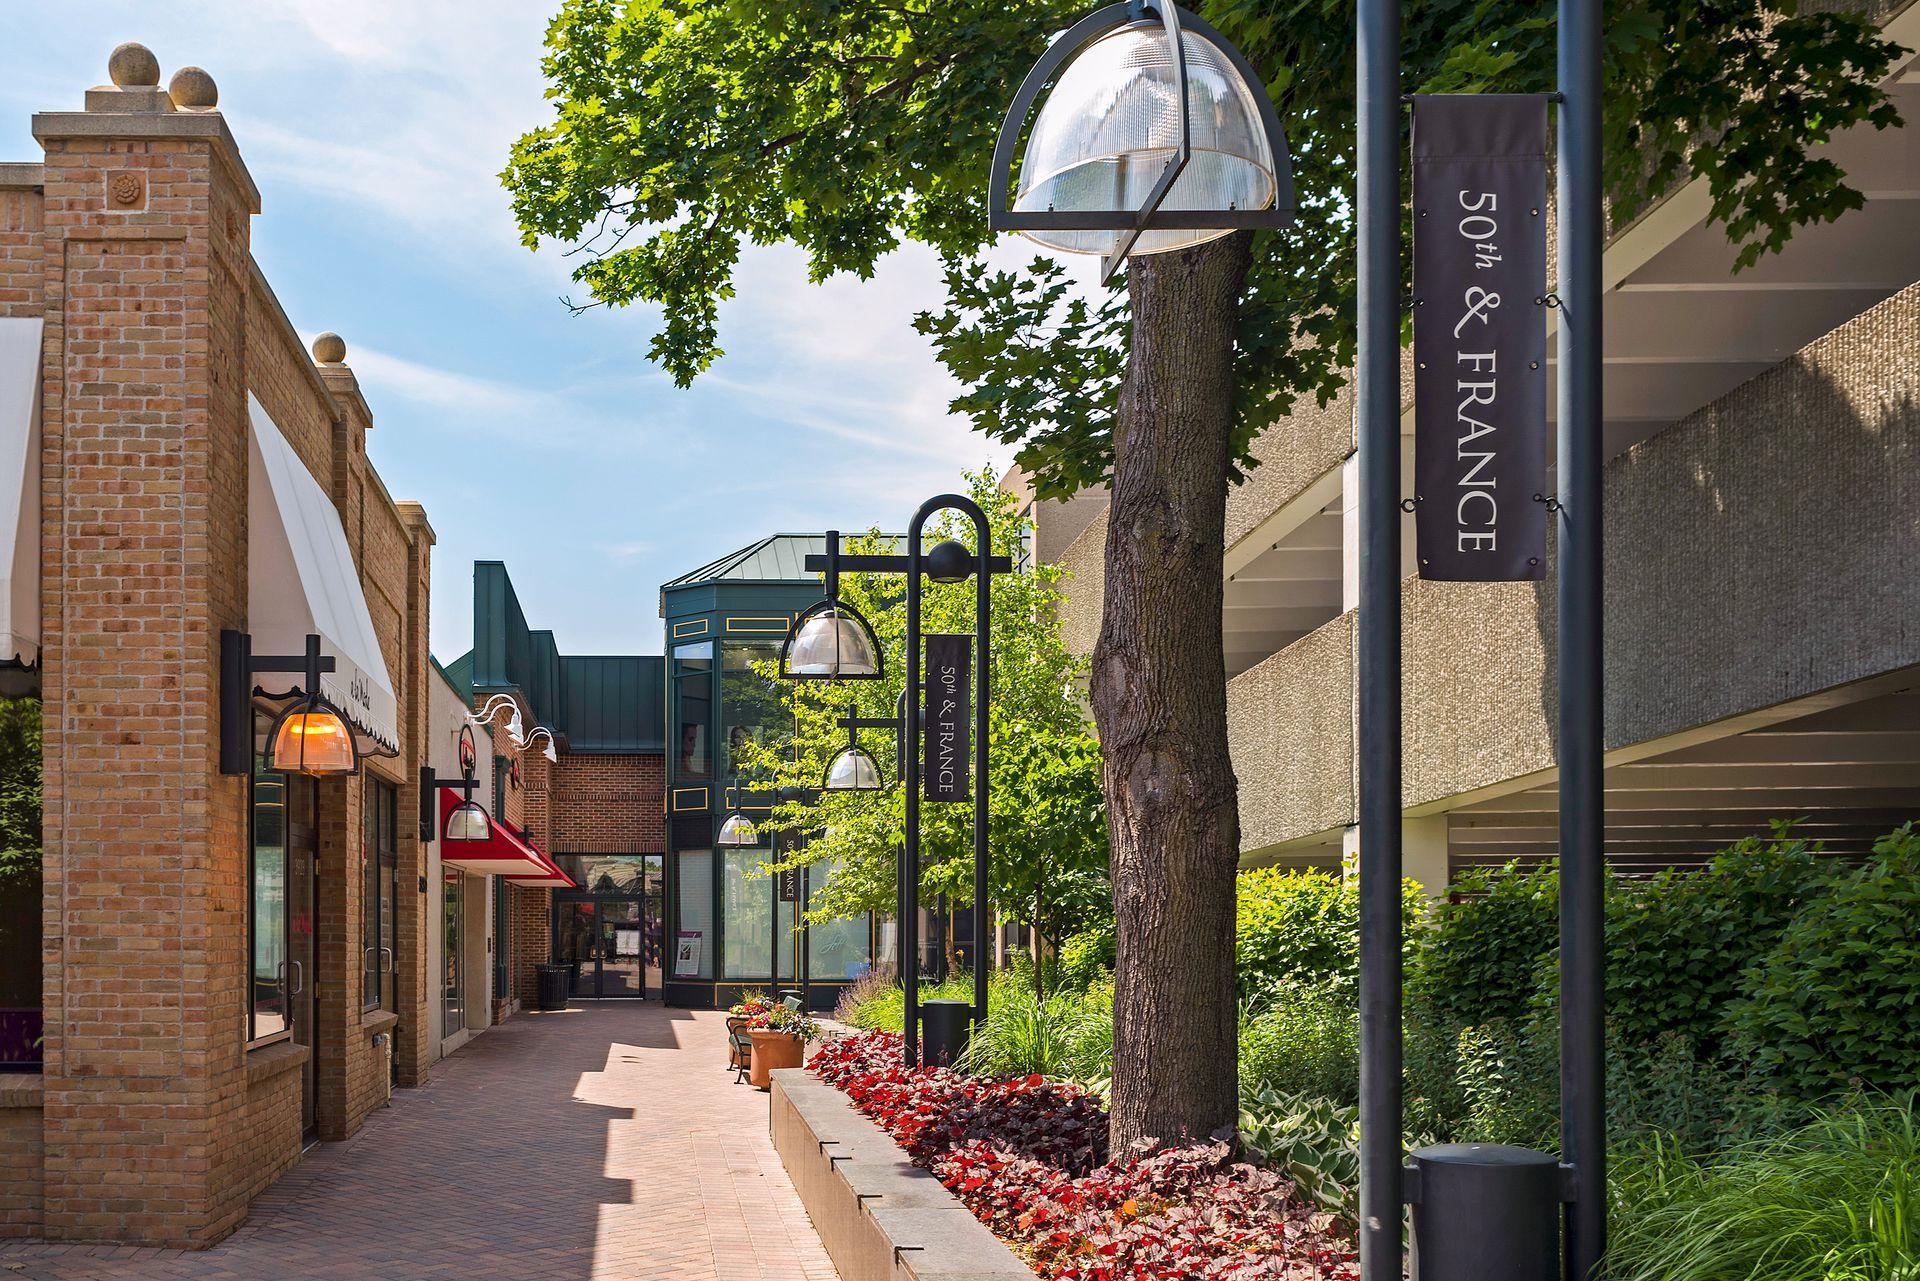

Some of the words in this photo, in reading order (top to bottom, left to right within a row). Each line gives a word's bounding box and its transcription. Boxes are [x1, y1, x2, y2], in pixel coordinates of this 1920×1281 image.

[1458, 190, 1503, 270] 50th
[1453, 285, 1501, 339] &
[1457, 349, 1497, 553] FRANCE
[938, 699, 957, 719] &
[940, 665, 957, 694] 50th
[938, 722, 955, 793] FRANCE
